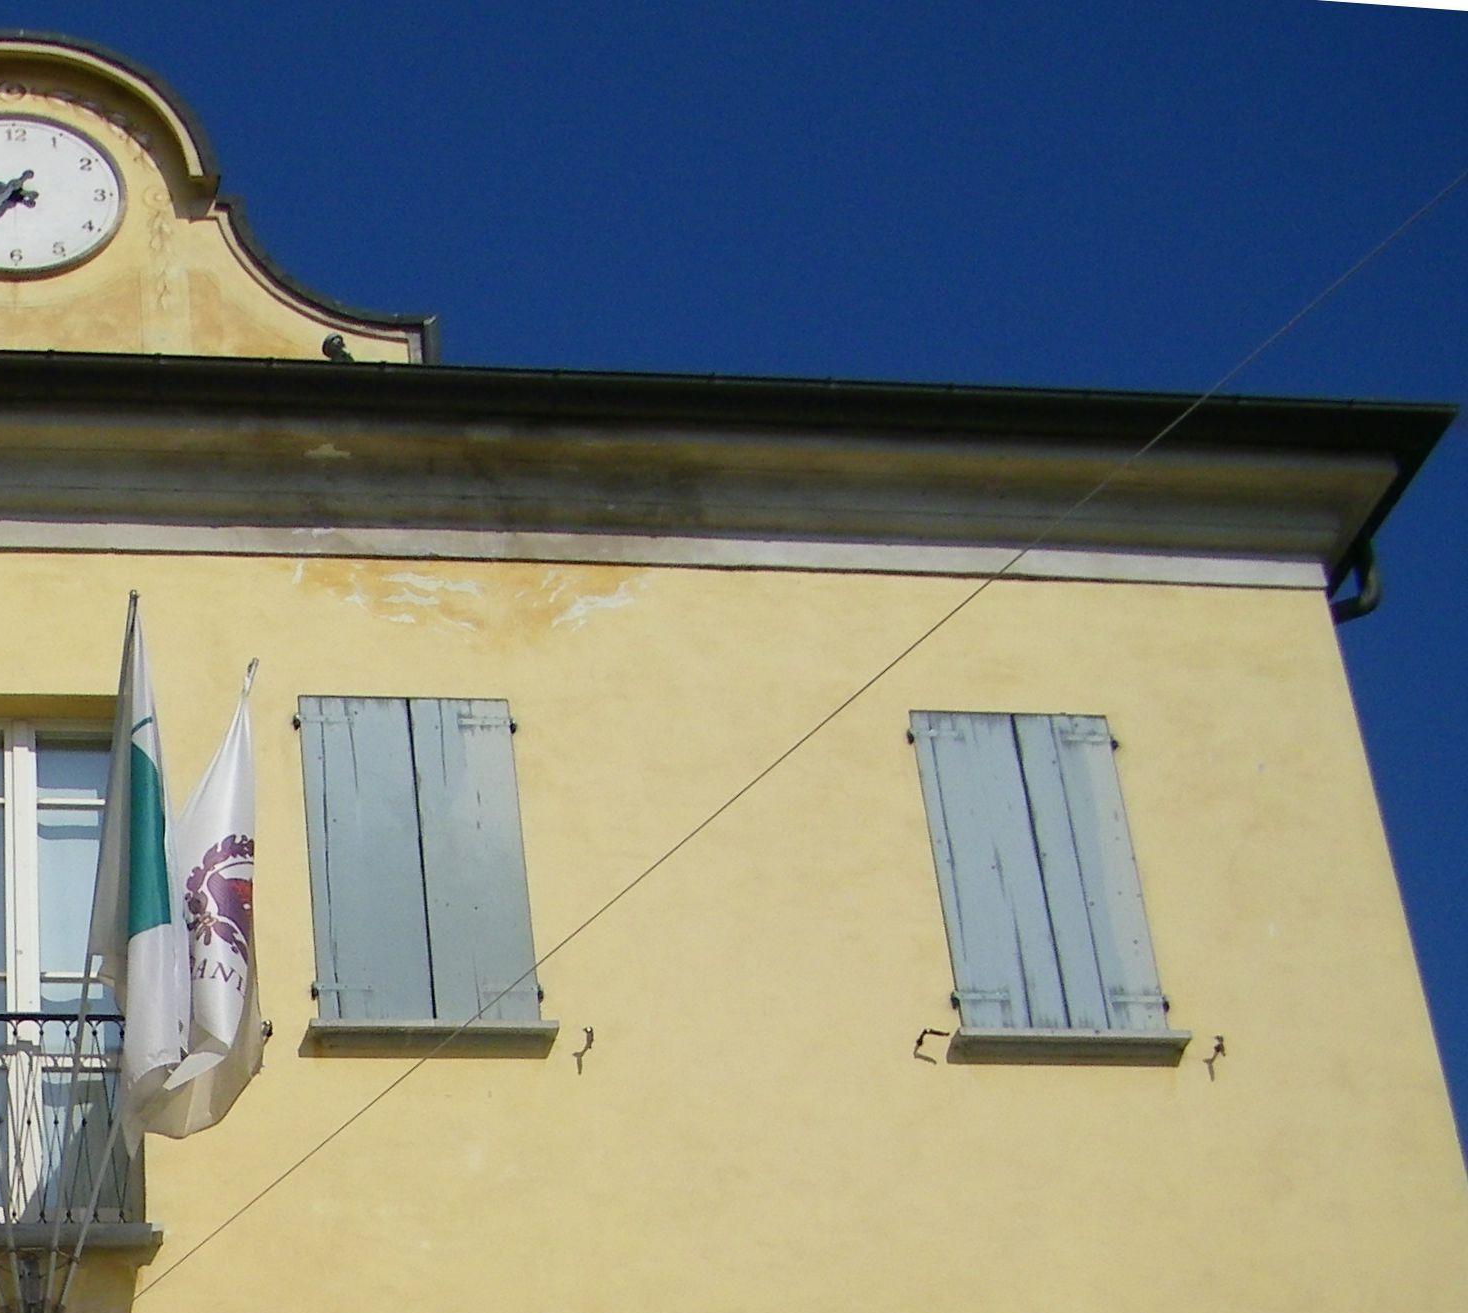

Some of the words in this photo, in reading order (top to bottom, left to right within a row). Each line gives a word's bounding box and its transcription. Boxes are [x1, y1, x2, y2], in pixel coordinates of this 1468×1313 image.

[5, 128, 27, 142] 12
[50, 136, 58, 148] 1
[79, 157, 93, 171] 2
[93, 188, 107, 201] 3
[82, 219, 94, 233] 4
[51, 241, 66, 255] 5
[10, 249, 23, 262] 6
